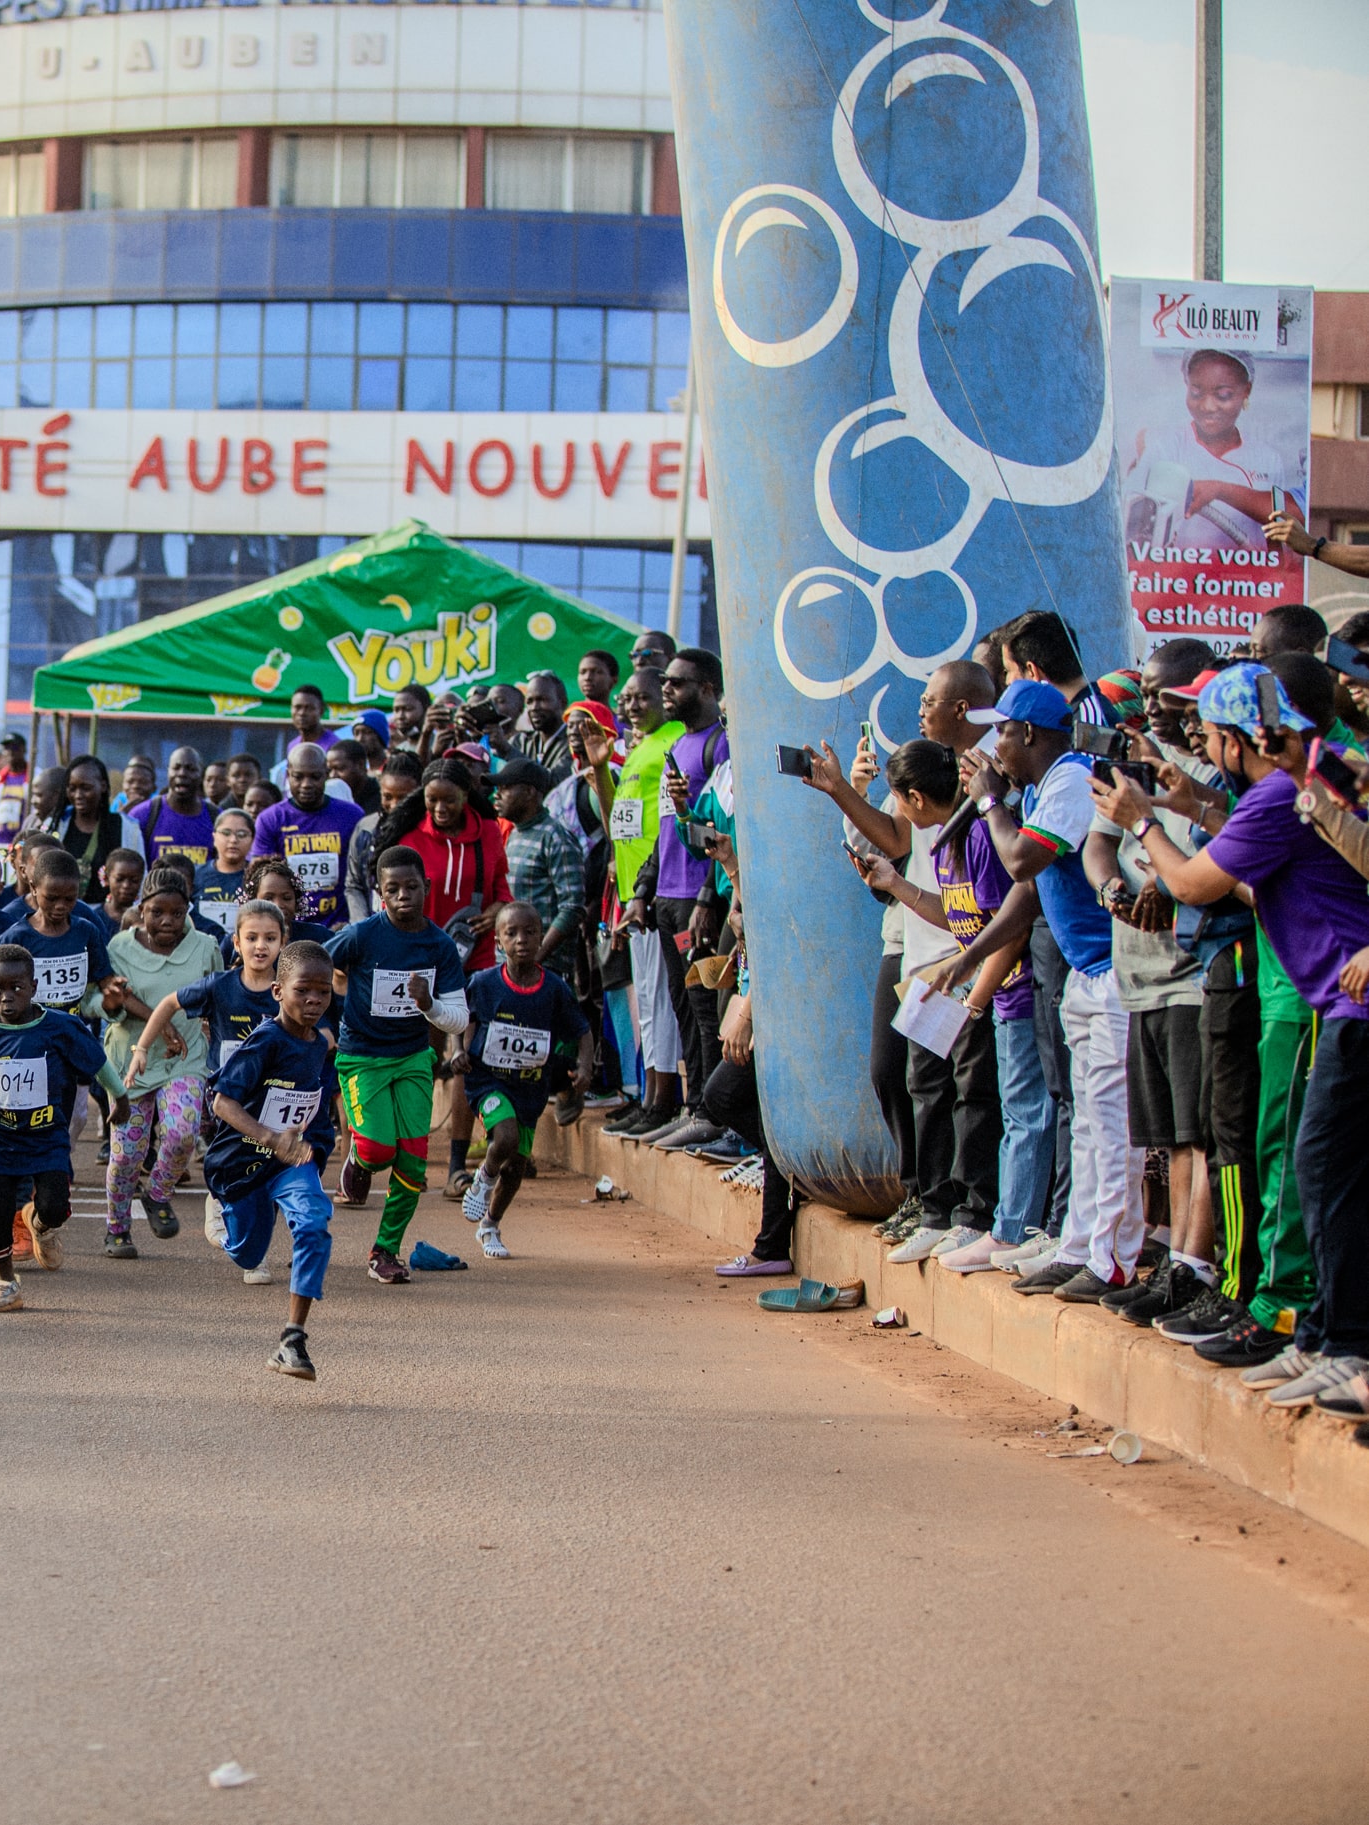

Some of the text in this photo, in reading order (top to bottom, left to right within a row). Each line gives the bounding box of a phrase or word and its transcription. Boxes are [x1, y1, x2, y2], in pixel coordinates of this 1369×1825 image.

[1212, 308, 1260, 332] BEAUTY
[129, 435, 327, 496] AUBE
[1132, 541, 1279, 567] Venez vous
[1131, 571, 1284, 598] faire former
[298, 862, 330, 876] 678
[42, 966, 80, 985] 135
[499, 1036, 538, 1056] 104
